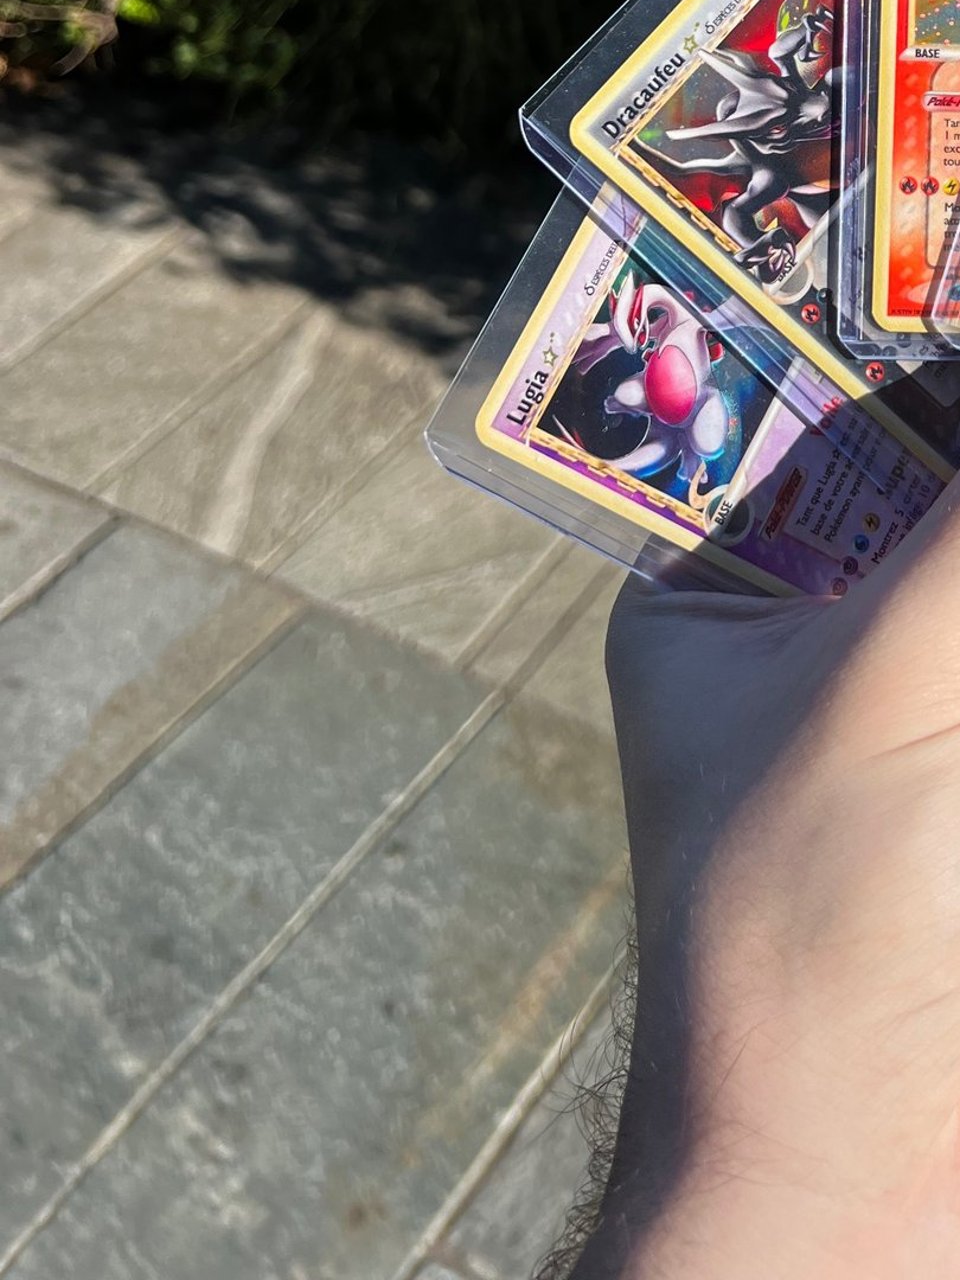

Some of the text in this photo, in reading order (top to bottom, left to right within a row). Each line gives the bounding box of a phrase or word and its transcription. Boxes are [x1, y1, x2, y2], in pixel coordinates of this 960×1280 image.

[915, 49, 940, 58] BASE
[600, 48, 686, 139] Dracaufeu
[505, 366, 555, 428] Lugia
[817, 459, 839, 486] Lugia
[714, 499, 733, 525] BASE
[809, 485, 826, 506] que
[809, 511, 828, 535] base
[821, 497, 835, 511] de
[831, 471, 849, 497] votre
[795, 504, 814, 528] Tant
[823, 496, 854, 543] Pokémon
[870, 520, 899, 564] Montrez
[893, 507, 904, 517] 5
